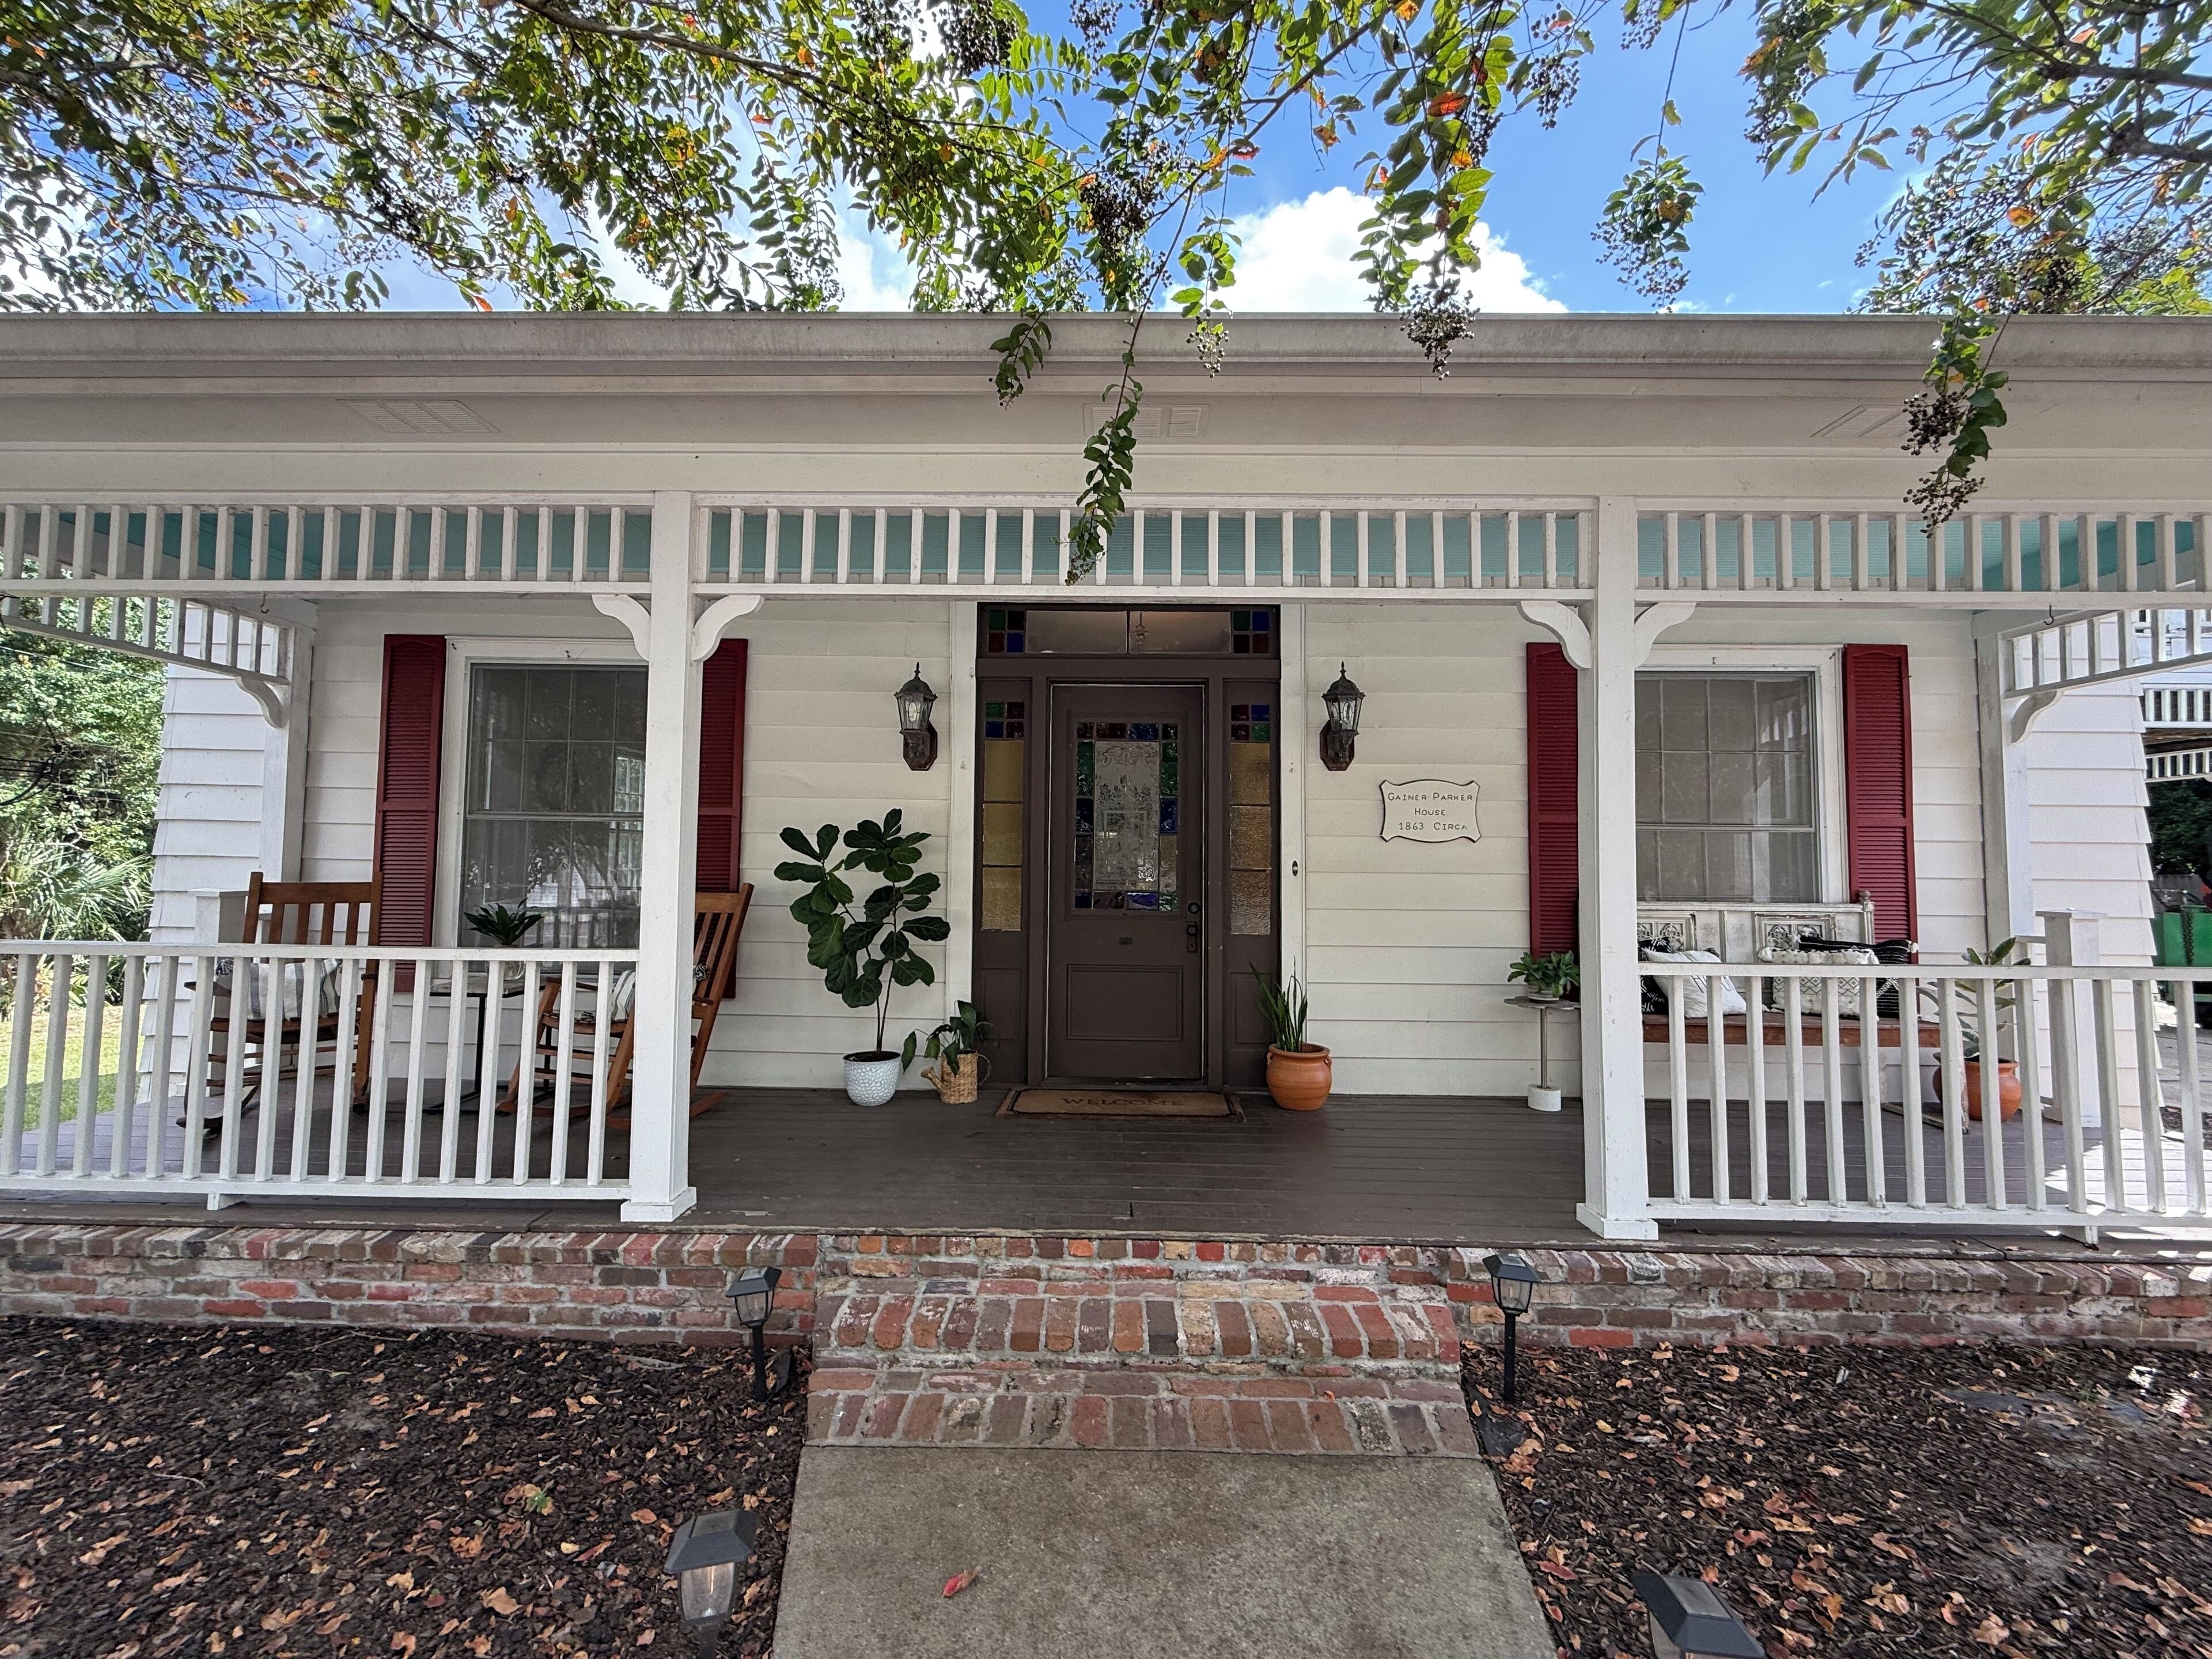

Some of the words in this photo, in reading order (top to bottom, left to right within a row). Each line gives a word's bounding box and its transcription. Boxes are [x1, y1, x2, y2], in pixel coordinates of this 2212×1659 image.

[1388, 792, 1427, 801] GAINER
[1433, 792, 1473, 801] PARKER
[1414, 808, 1446, 816] HOUSE
[1399, 821, 1424, 830] 1863
[1434, 822, 1468, 830] CIRCA
